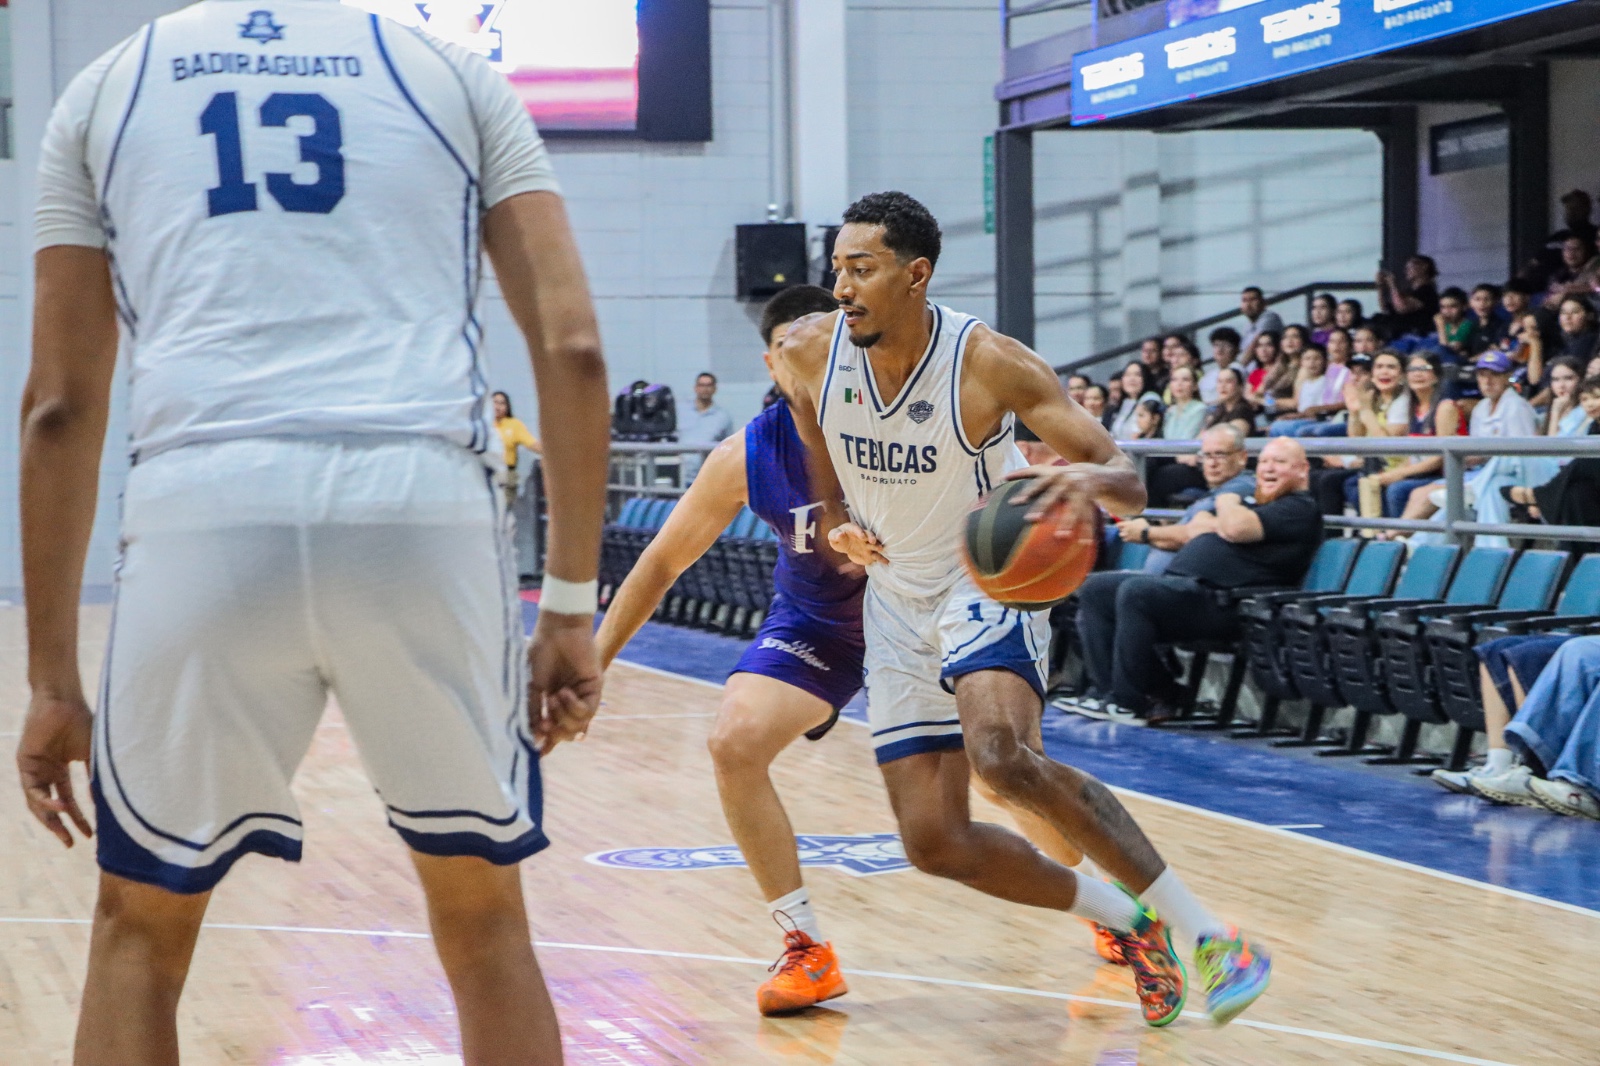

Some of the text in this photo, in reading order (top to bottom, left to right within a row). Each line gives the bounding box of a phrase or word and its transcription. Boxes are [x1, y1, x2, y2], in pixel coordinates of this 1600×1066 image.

[172, 53, 362, 81] BADIRAGUATO
[198, 91, 346, 217] 13
[840, 432, 938, 474] TEBICAS
